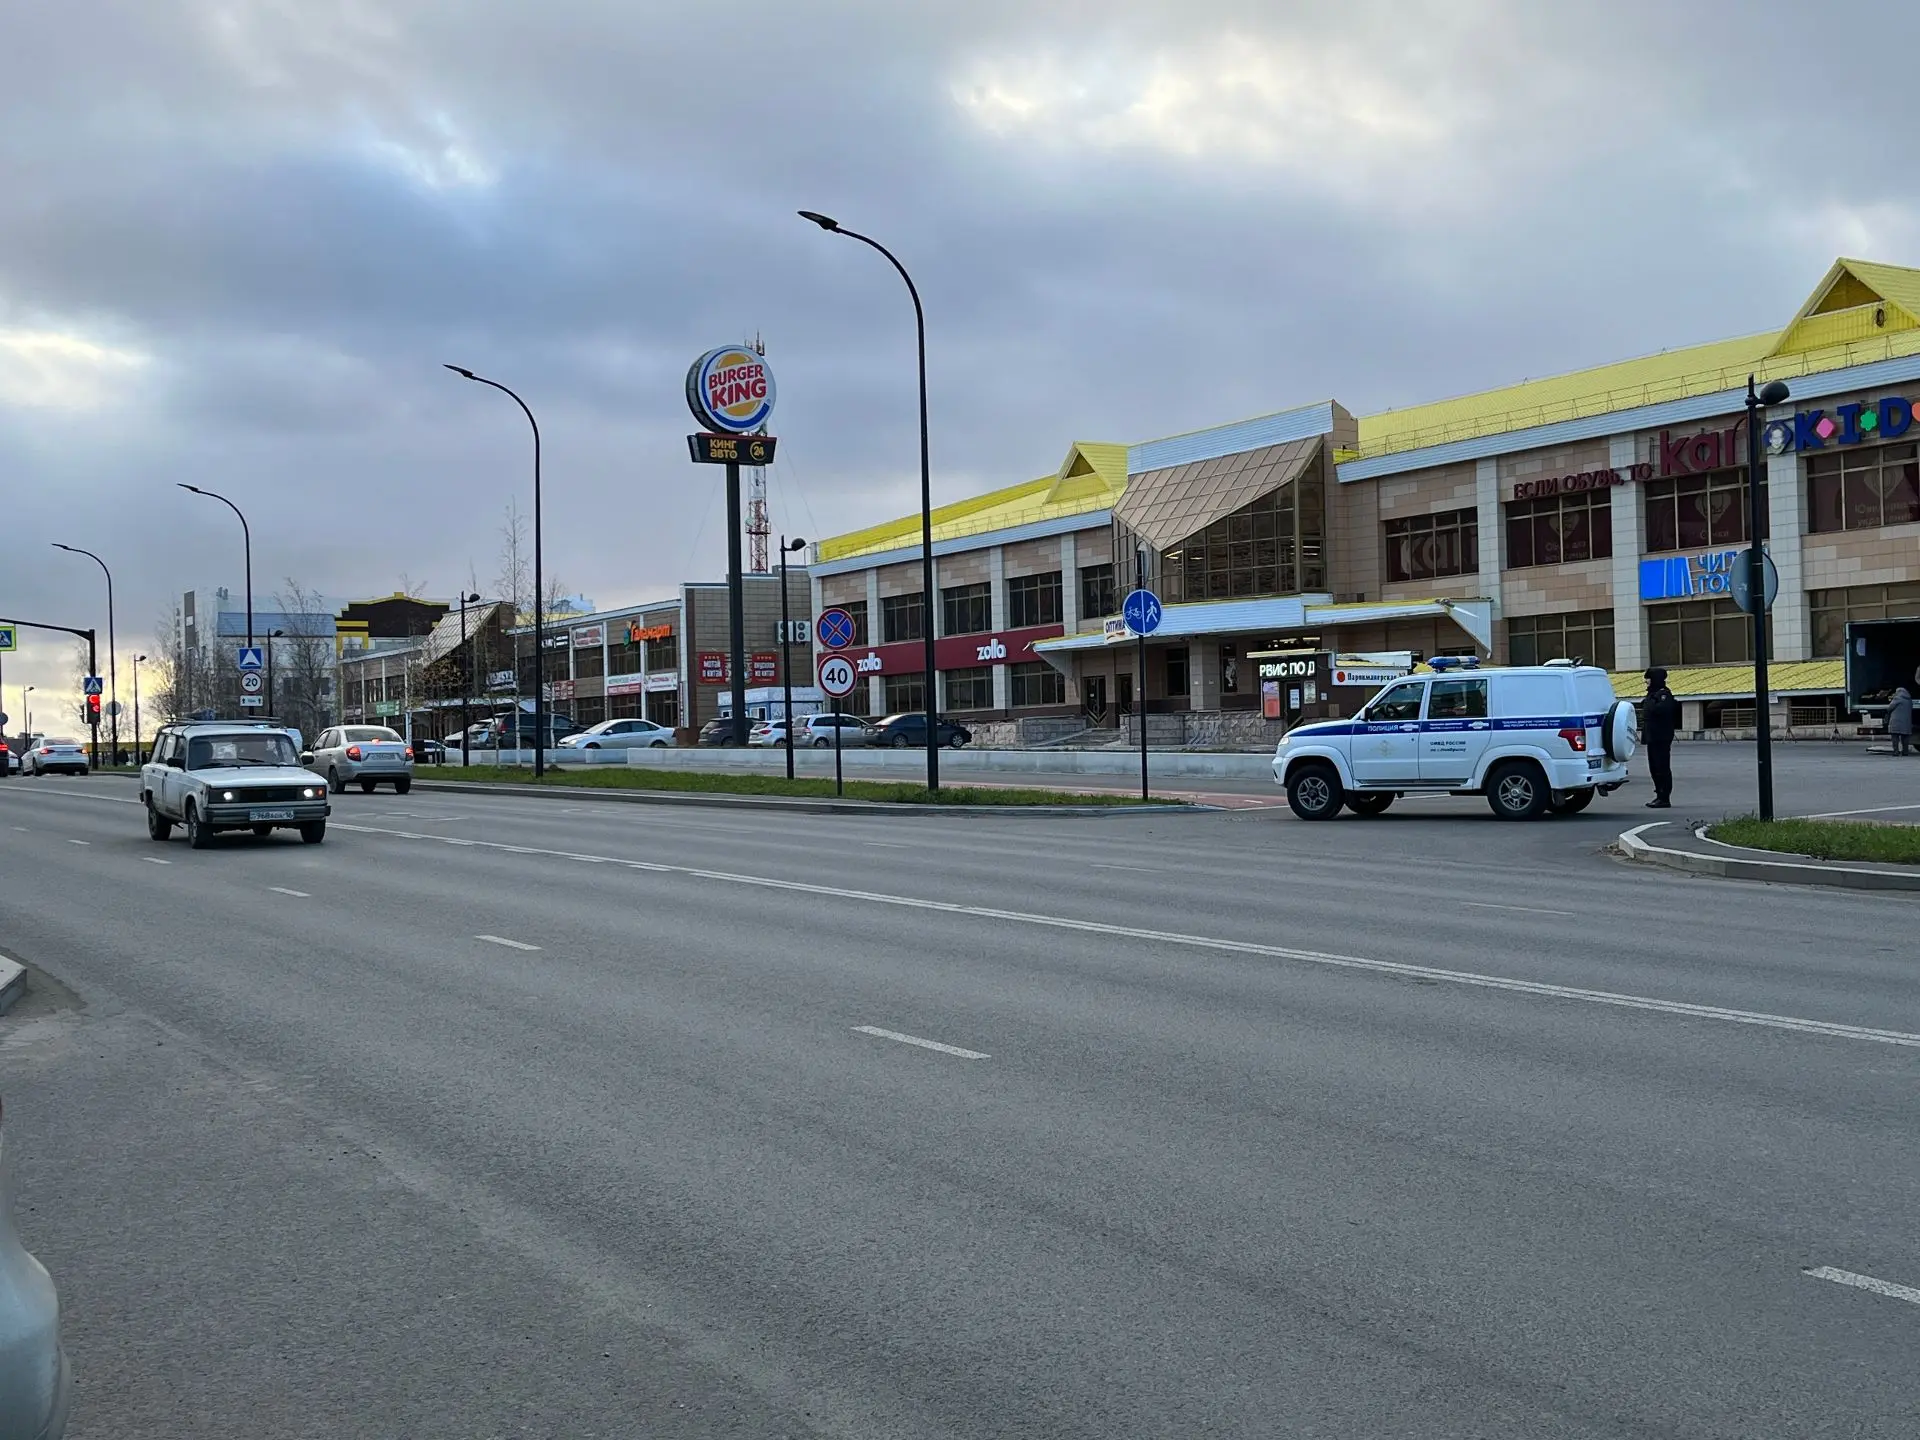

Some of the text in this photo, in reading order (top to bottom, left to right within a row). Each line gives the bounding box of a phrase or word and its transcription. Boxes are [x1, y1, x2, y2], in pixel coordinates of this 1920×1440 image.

[709, 364, 764, 390] BURGER
[711, 378, 766, 411] KING
[710, 439, 737, 449] КИНГ
[753, 445, 765, 456] 24
[1660, 416, 1749, 477] kar
[1513, 477, 1559, 500] ЕСЛИ
[1628, 462, 1653, 481] ТО
[1696, 550, 1738, 573] ЧИТ
[976, 639, 1007, 661] zolla
[857, 652, 883, 672] zolla
[1259, 662, 1288, 677] РВИС
[1289, 661, 1305, 675] ПО
[245, 677, 258, 687] 20
[825, 667, 848, 685] 40
